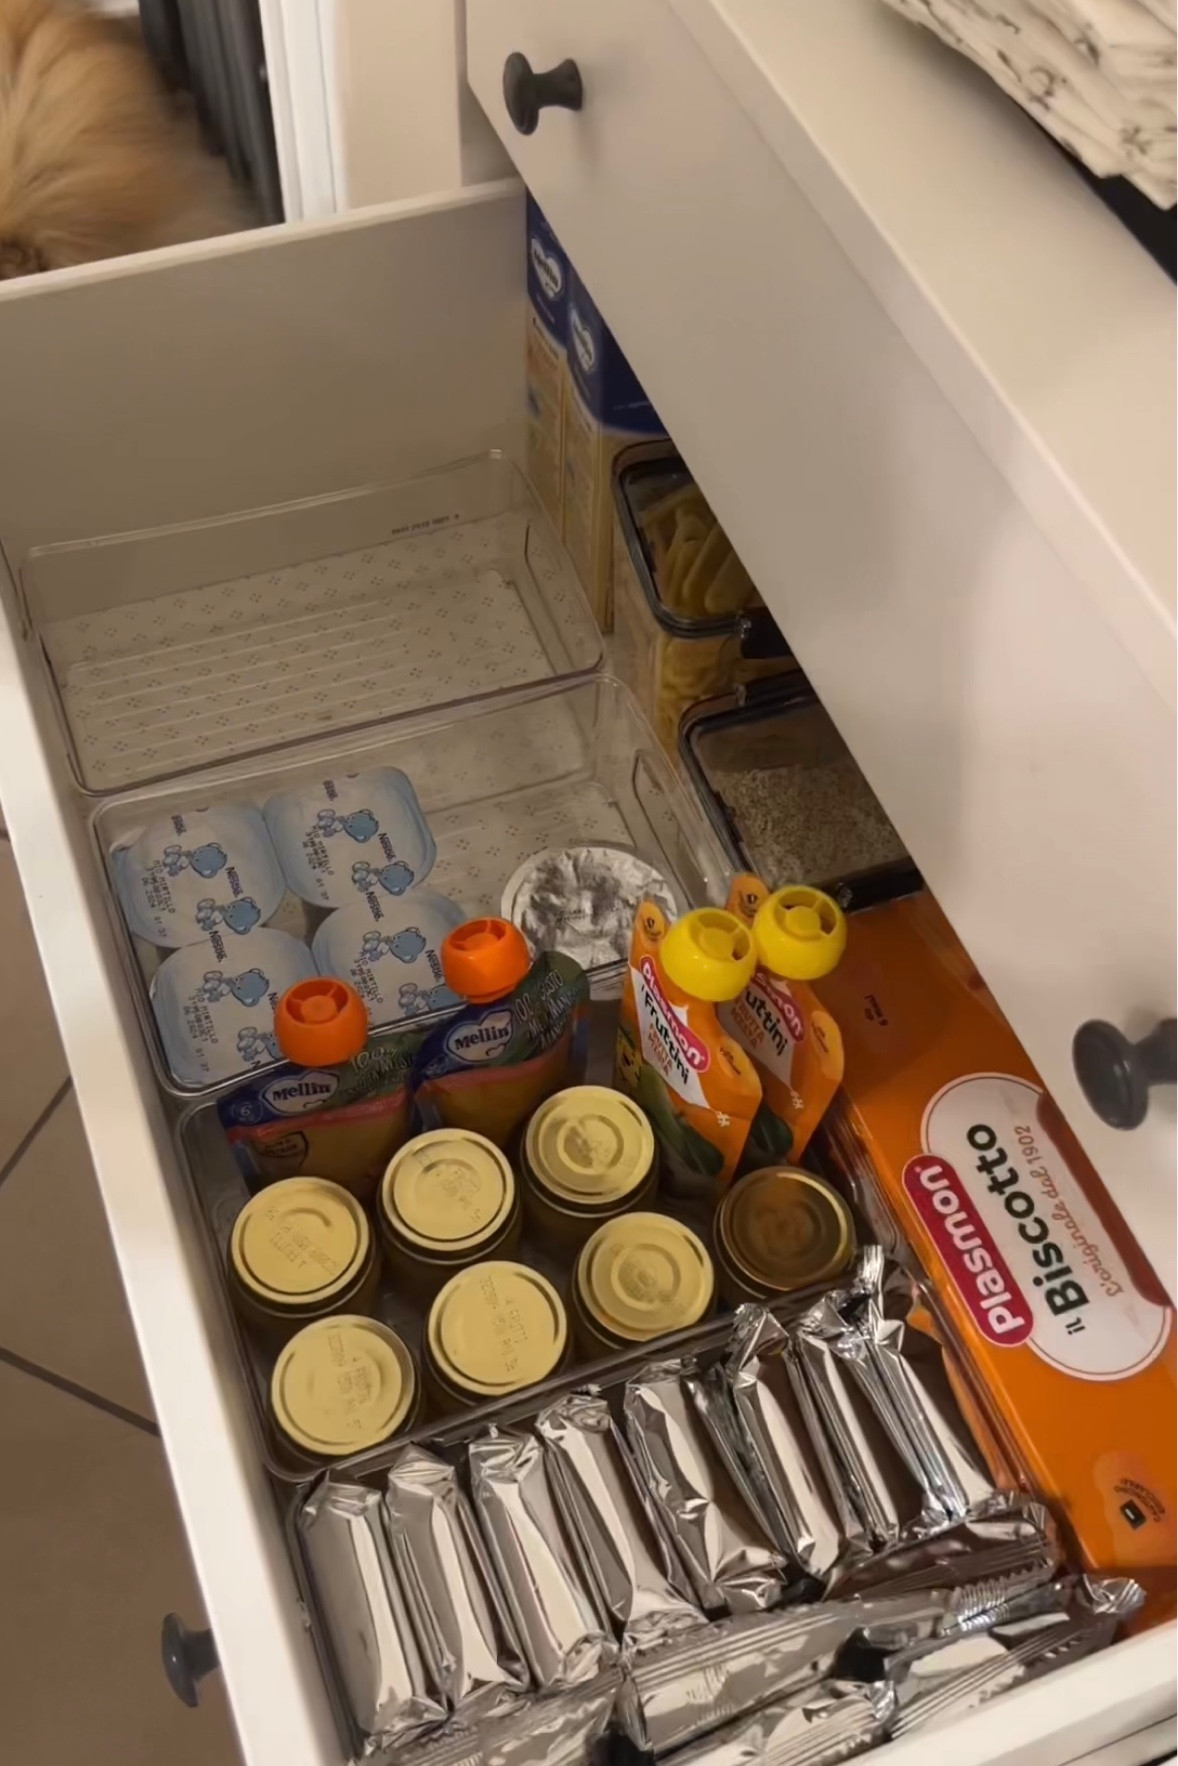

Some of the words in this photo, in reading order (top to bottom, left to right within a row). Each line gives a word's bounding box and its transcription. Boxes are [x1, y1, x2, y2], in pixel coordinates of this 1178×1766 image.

[159, 876, 176, 914] MIRTILLO
[365, 891, 385, 922] Nestlé
[209, 930, 228, 963] Nestlé
[425, 949, 443, 982] Nestlé
[366, 968, 384, 1004] MIRTILLO
[202, 1005, 219, 1045] MIRTILLO
[643, 962, 701, 1066] Plasmon
[745, 990, 788, 1056] uttini
[455, 1026, 510, 1051] Mellin
[644, 990, 690, 1085] Fruttini
[273, 1082, 331, 1101] Mellin
[1014, 1125, 1042, 1164] 1902
[1029, 1165, 1059, 1203] dal
[967, 1124, 1091, 1316] Biscotto
[919, 1164, 1025, 1335] Plasmon
